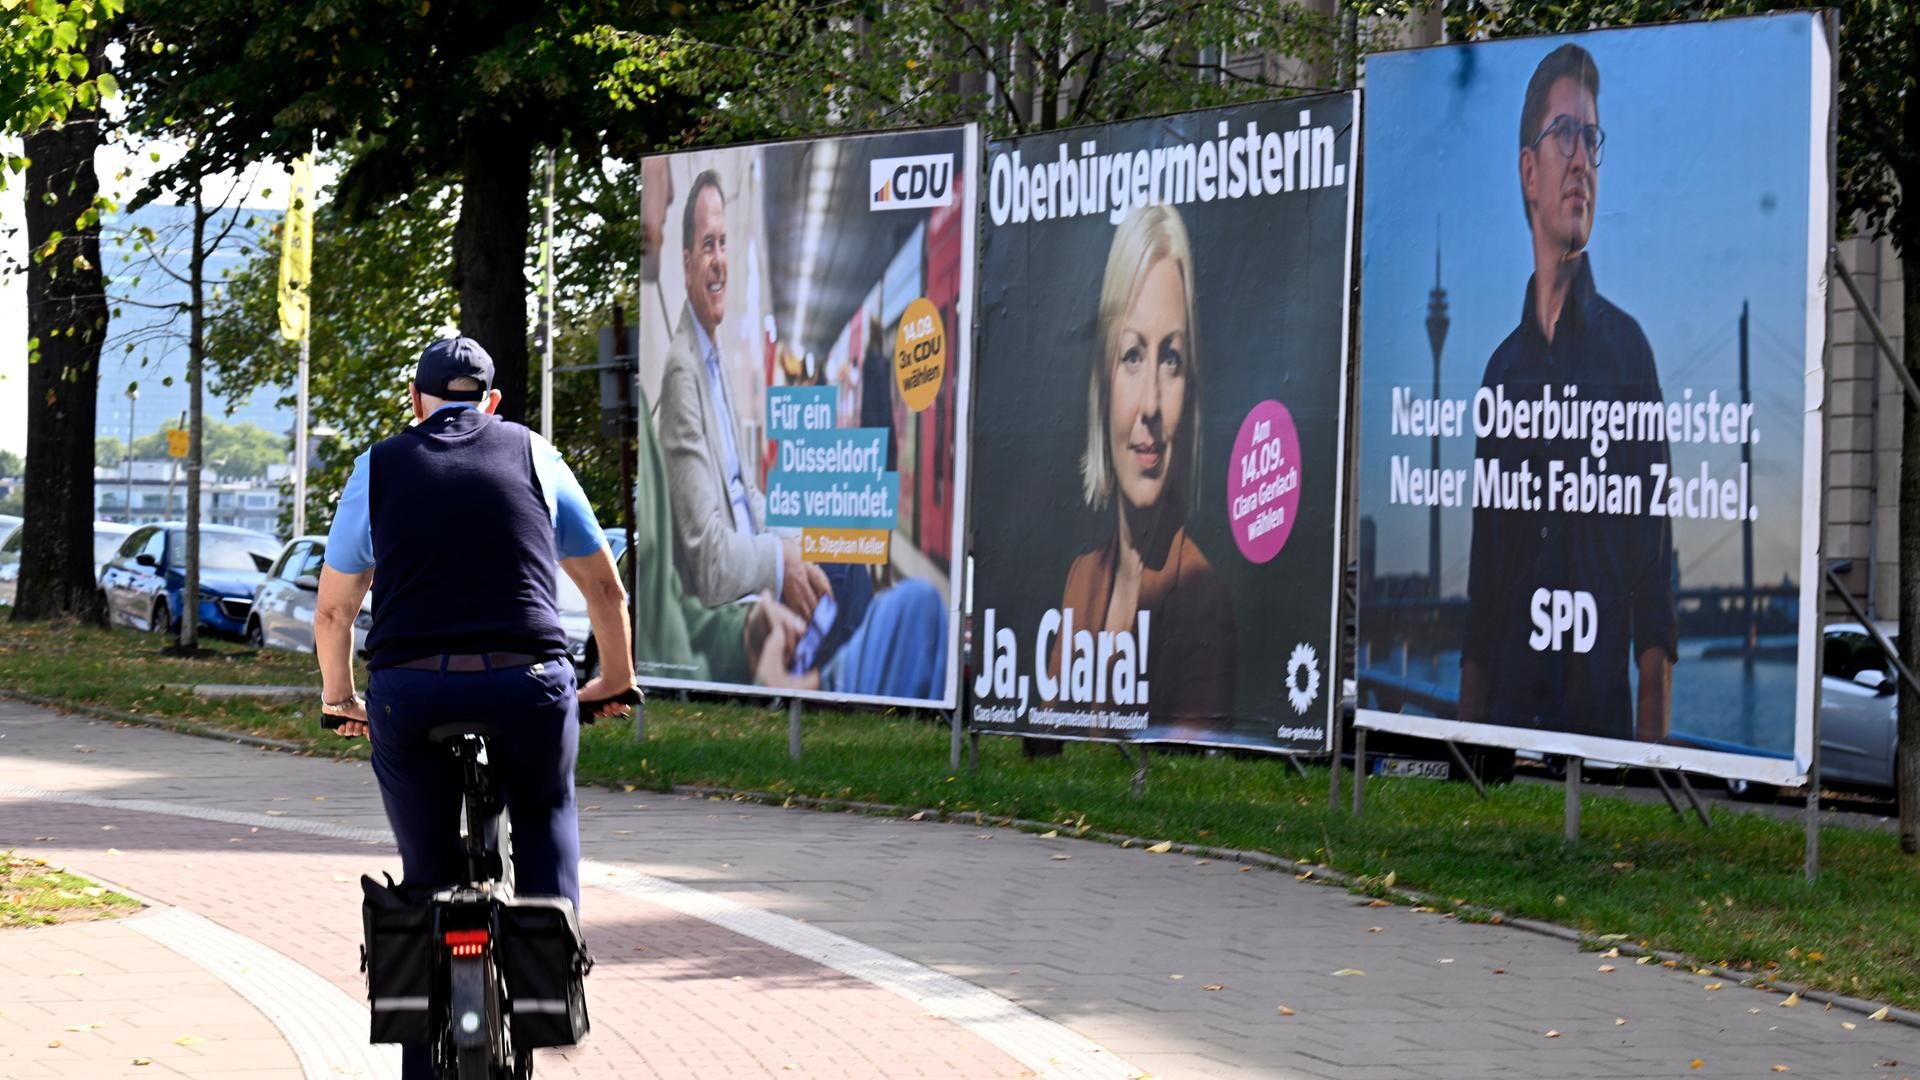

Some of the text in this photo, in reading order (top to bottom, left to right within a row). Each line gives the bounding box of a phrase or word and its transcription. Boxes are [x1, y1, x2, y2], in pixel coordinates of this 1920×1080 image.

[892, 162, 949, 201] CDU
[989, 109, 1345, 226] Oberbürgermeisterin.
[903, 315, 935, 343] 14.09.
[913, 335, 942, 362] CDU
[903, 365, 941, 392] wählen
[770, 394, 832, 430] Für ein
[1391, 383, 1760, 458] Neuer Oberbürgermeister.
[1251, 419, 1271, 447] Am
[782, 438, 882, 481] Düsseldorf,
[1241, 437, 1285, 488] 14.09.
[769, 482, 893, 517] das verbindet.
[1233, 466, 1297, 521] Clara Gerlach
[1390, 455, 1758, 521] Neuer Mut: Fabian Zachel.
[1248, 506, 1285, 542] wählen
[805, 535, 885, 558] Dr. Stephan Keller
[1528, 586, 1598, 653] SPD
[974, 607, 1151, 718] Ja, Clara!
